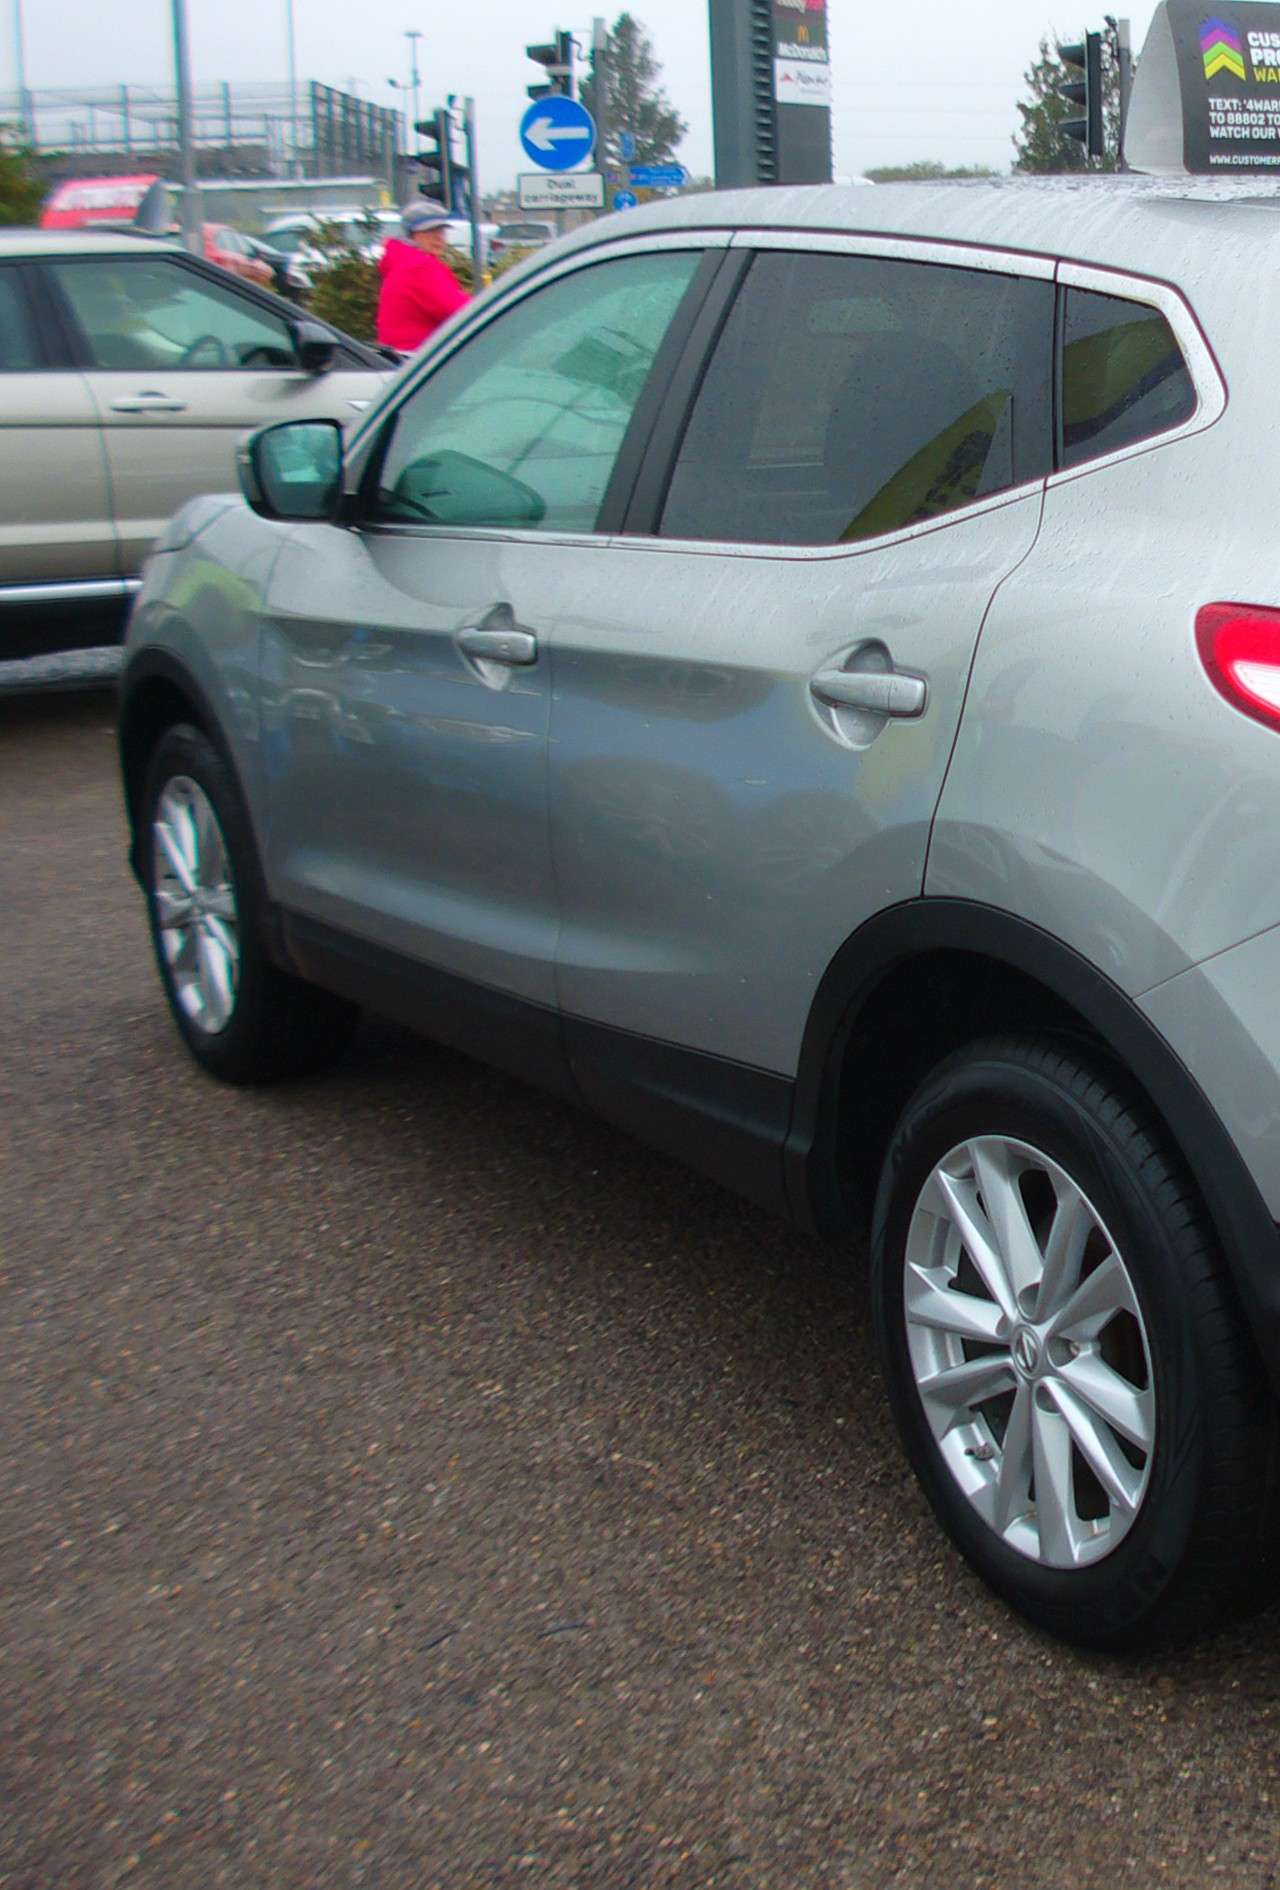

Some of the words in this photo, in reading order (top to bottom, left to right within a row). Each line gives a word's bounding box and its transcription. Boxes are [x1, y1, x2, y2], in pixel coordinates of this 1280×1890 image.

[1208, 97, 1243, 112] TEXT:
[1208, 112, 1226, 125] TO
[1227, 112, 1266, 126] 88802
[1209, 126, 1251, 139] WATCH
[1252, 127, 1277, 140] OUR
